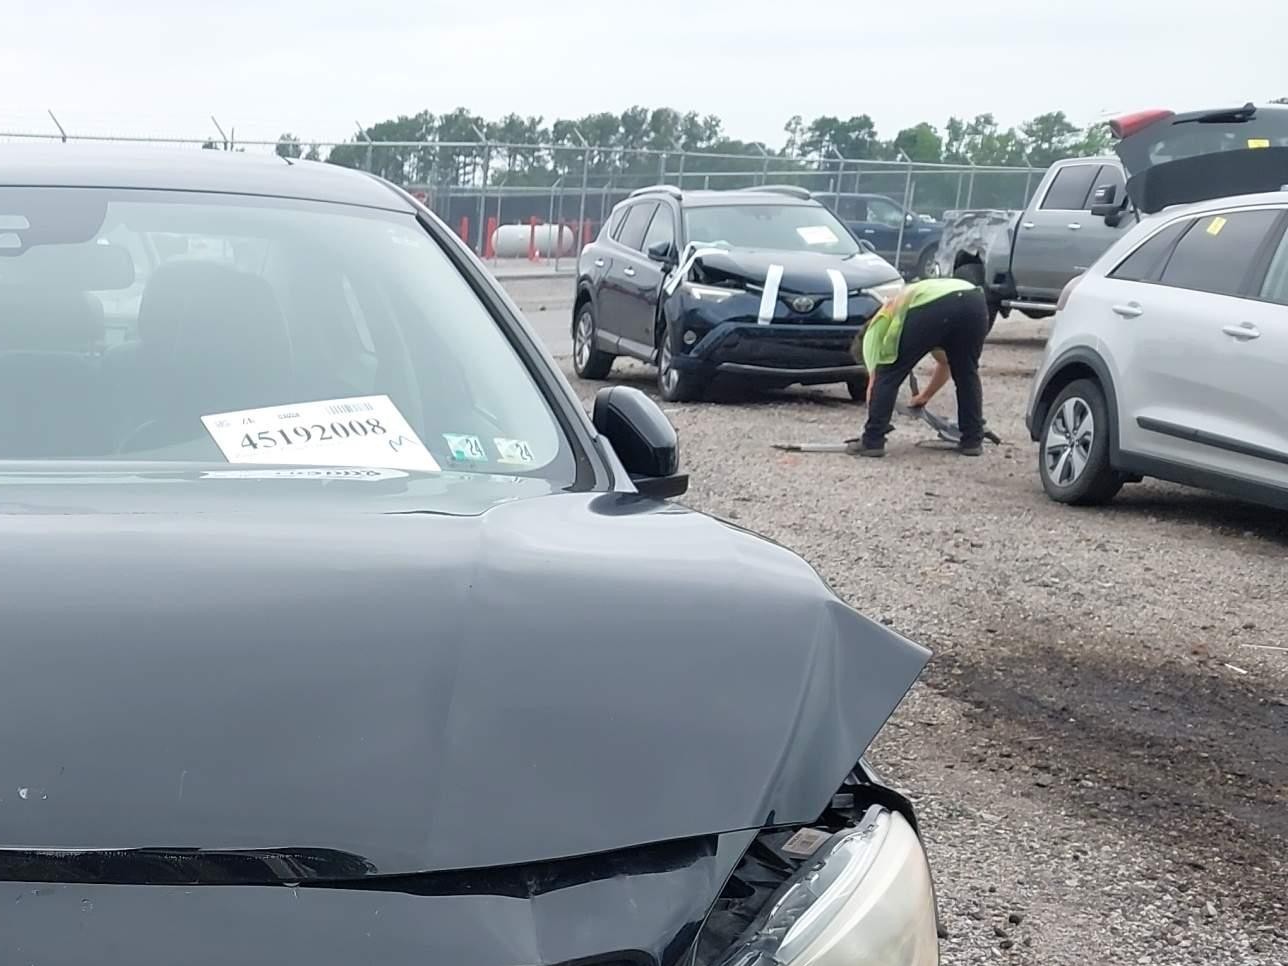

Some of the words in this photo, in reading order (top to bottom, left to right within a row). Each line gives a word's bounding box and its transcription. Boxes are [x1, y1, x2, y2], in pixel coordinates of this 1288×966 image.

[240, 416, 388, 450] 45192008
[465, 437, 484, 457] 24
[515, 442, 534, 462] 24
